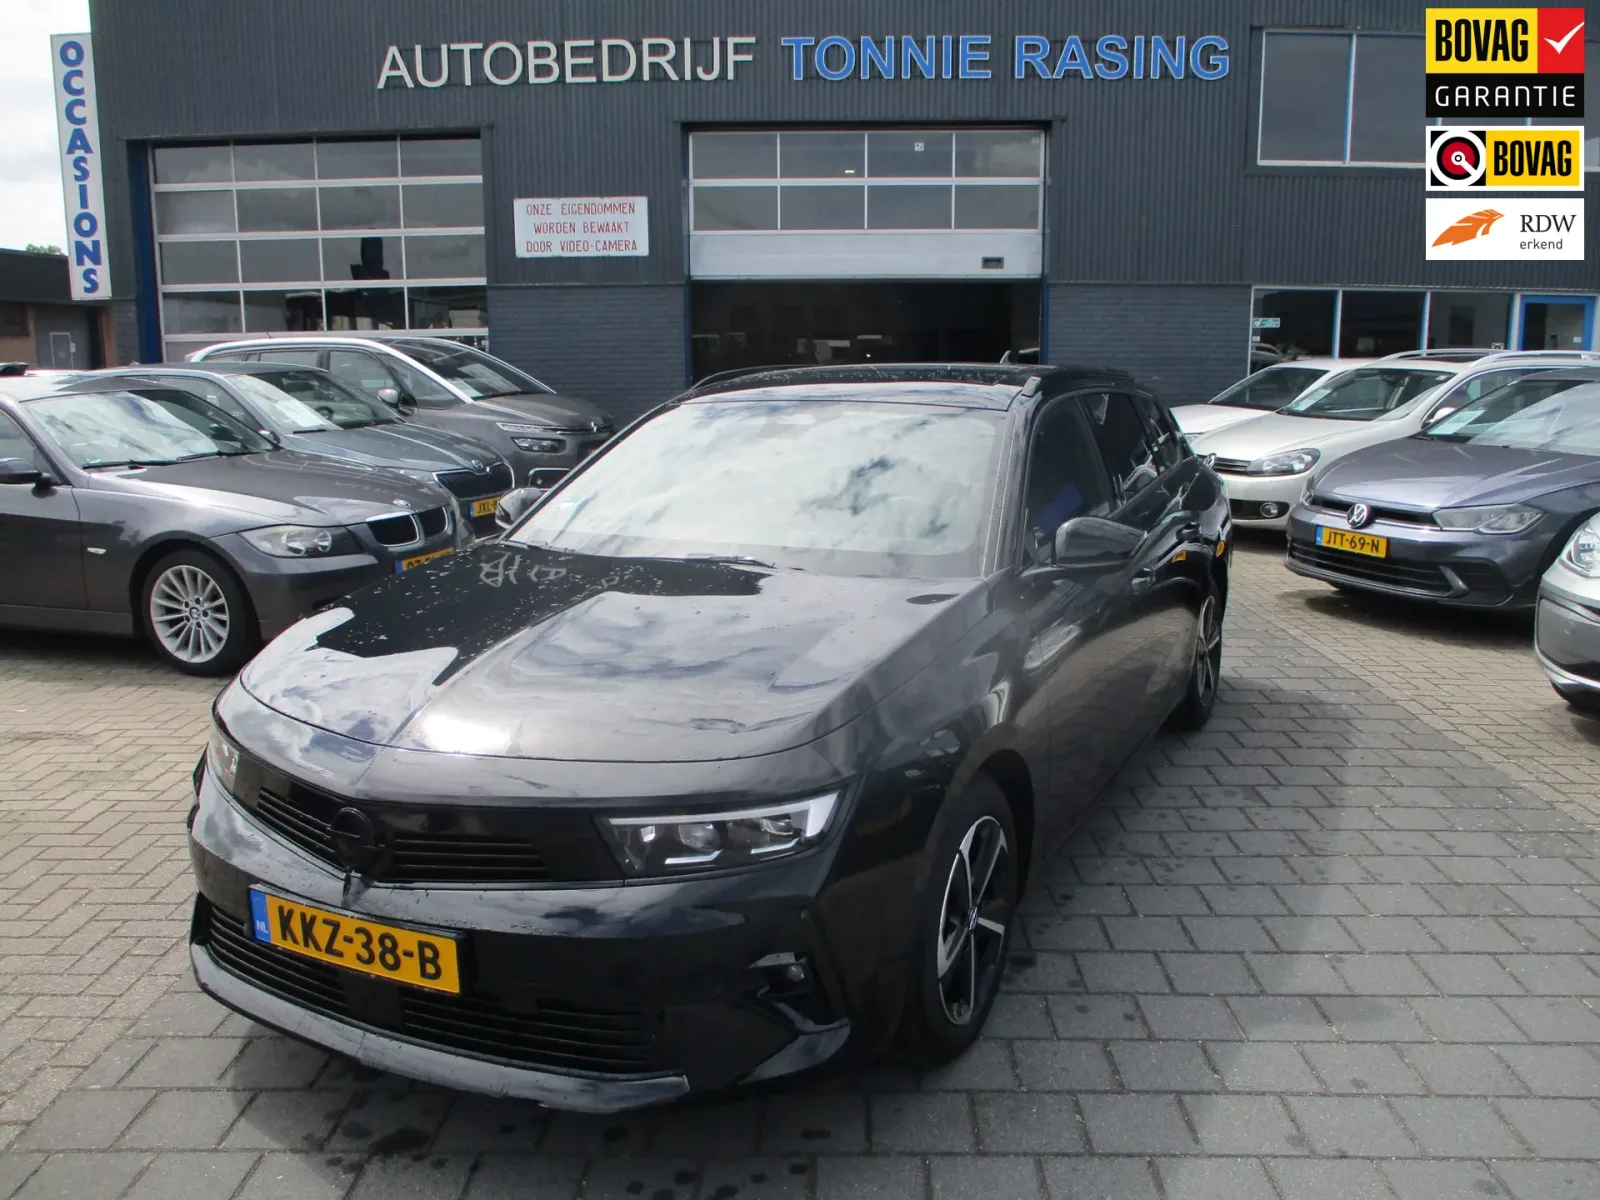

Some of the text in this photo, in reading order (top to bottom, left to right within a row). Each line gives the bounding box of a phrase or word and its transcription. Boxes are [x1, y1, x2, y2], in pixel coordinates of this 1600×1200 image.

[377, 35, 1230, 89] AUTOBEDRIJF TONNIE RASING
[59, 40, 103, 294] OCCASIONS
[526, 202, 636, 216] ONZE EIGENDOMMEN
[533, 221, 630, 234] WORDEN BEWAAKT
[526, 240, 638, 253] DOOR VIDEO-CAMERA
[1325, 531, 1380, 553] JTT-69-N
[256, 919, 269, 934] NL
[277, 904, 442, 981] KKZ-38-B
